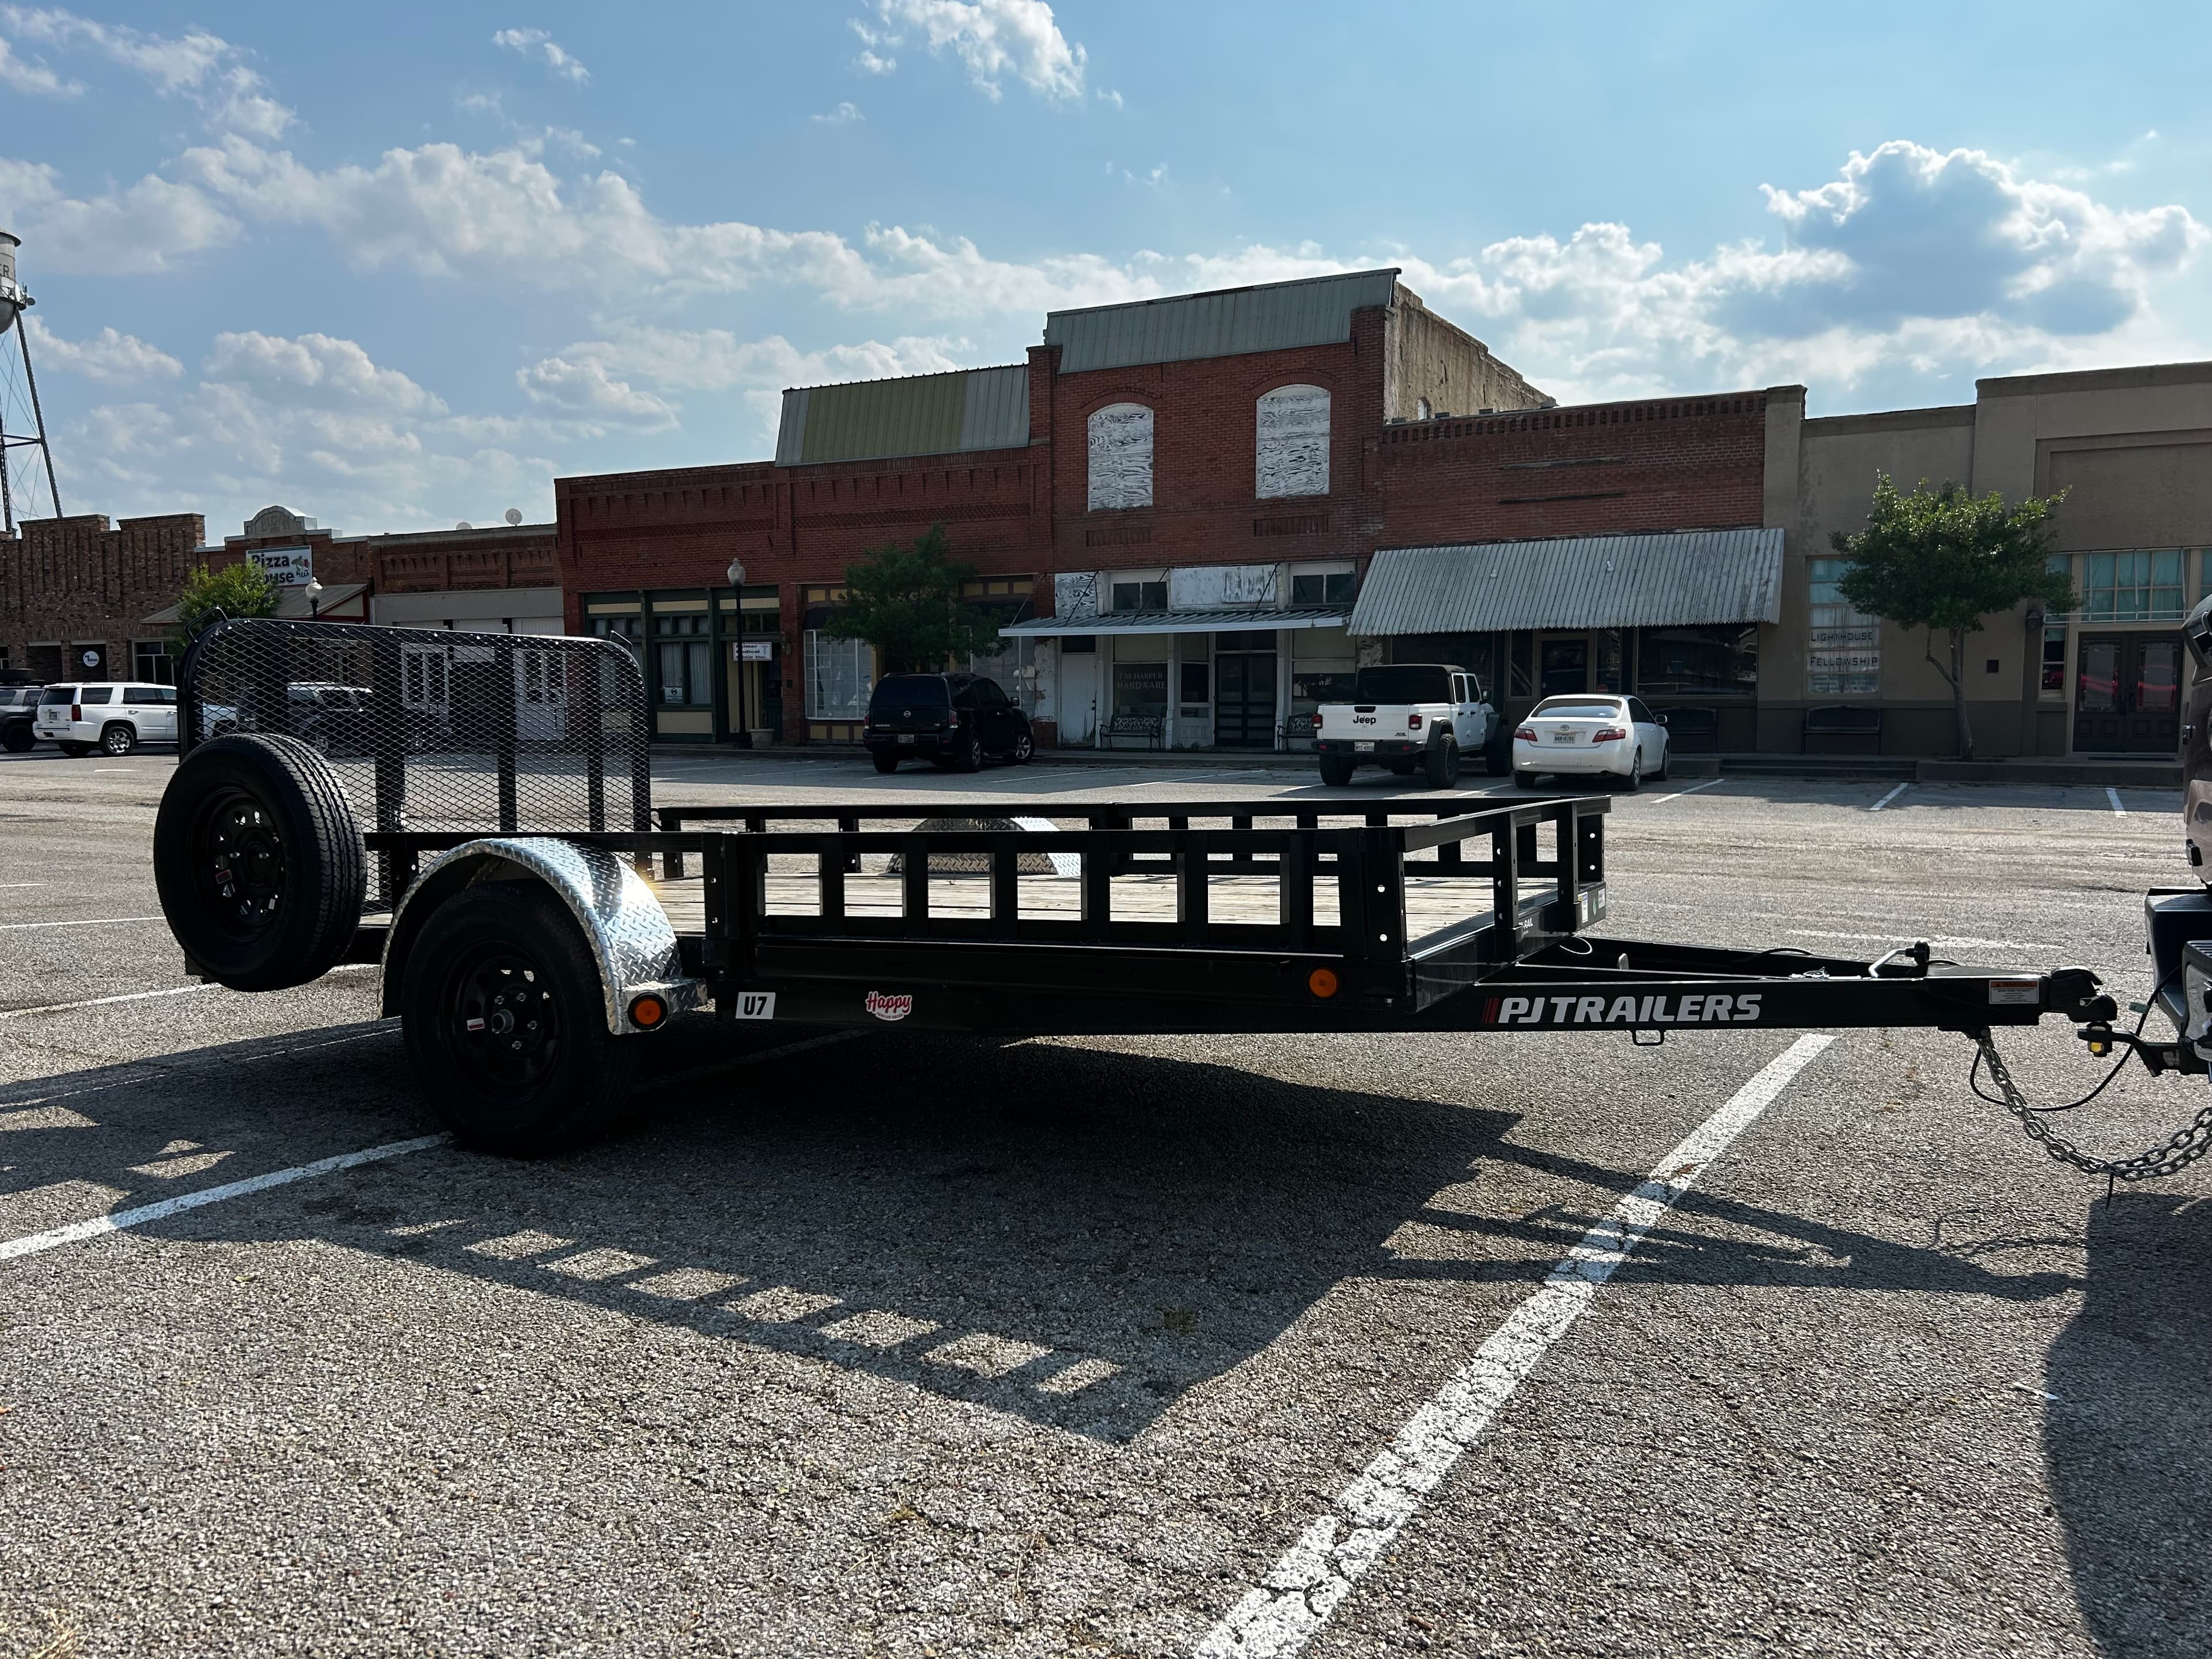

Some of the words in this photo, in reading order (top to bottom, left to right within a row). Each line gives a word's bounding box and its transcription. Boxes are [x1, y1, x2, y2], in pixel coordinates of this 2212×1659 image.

[252, 554, 290, 568] Pizza
[1810, 632, 1873, 642] LIGHTHOUSE
[1810, 657, 1877, 666] FELLOWSHIP
[1118, 681, 1166, 690] HARDWARE
[1353, 715, 1376, 725] Jeep
[744, 996, 768, 1016] U7
[866, 992, 911, 1014] Happy
[1498, 997, 1545, 1023] PJ
[1551, 994, 1763, 1023] TRAILERS
